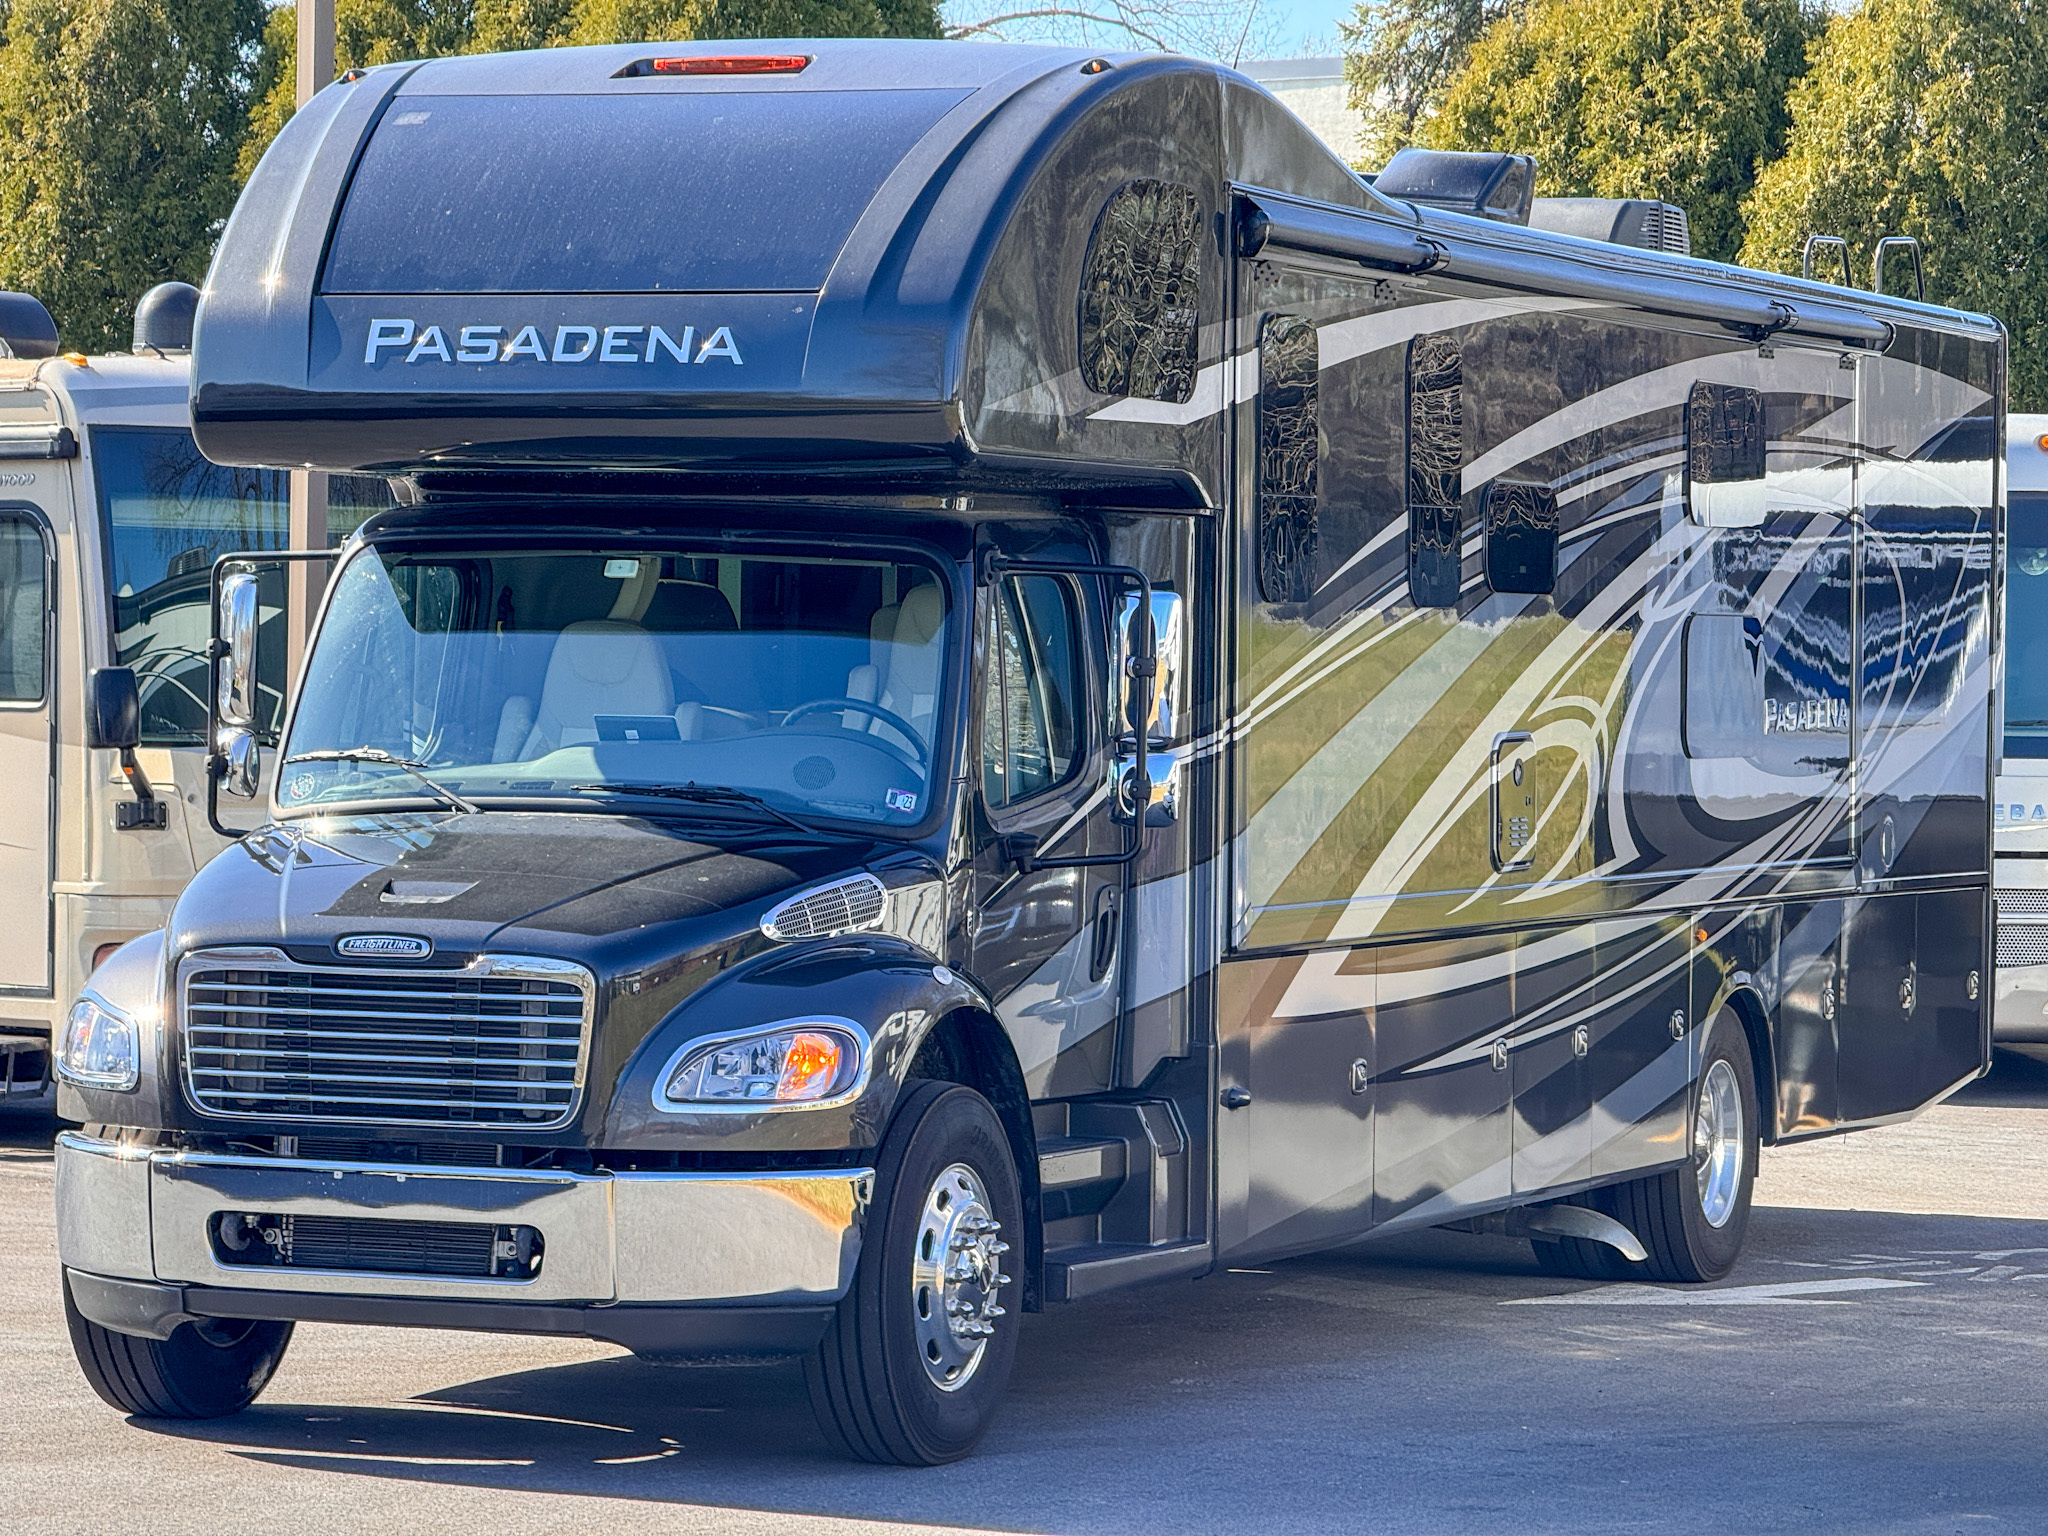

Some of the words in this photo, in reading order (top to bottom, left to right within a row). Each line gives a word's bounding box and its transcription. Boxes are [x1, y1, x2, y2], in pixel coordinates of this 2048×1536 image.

[364, 318, 744, 364] PASADENA
[1763, 698, 1849, 735] PASADENA
[903, 795, 914, 809] 23
[348, 939, 417, 950] FREIGHTLINER
